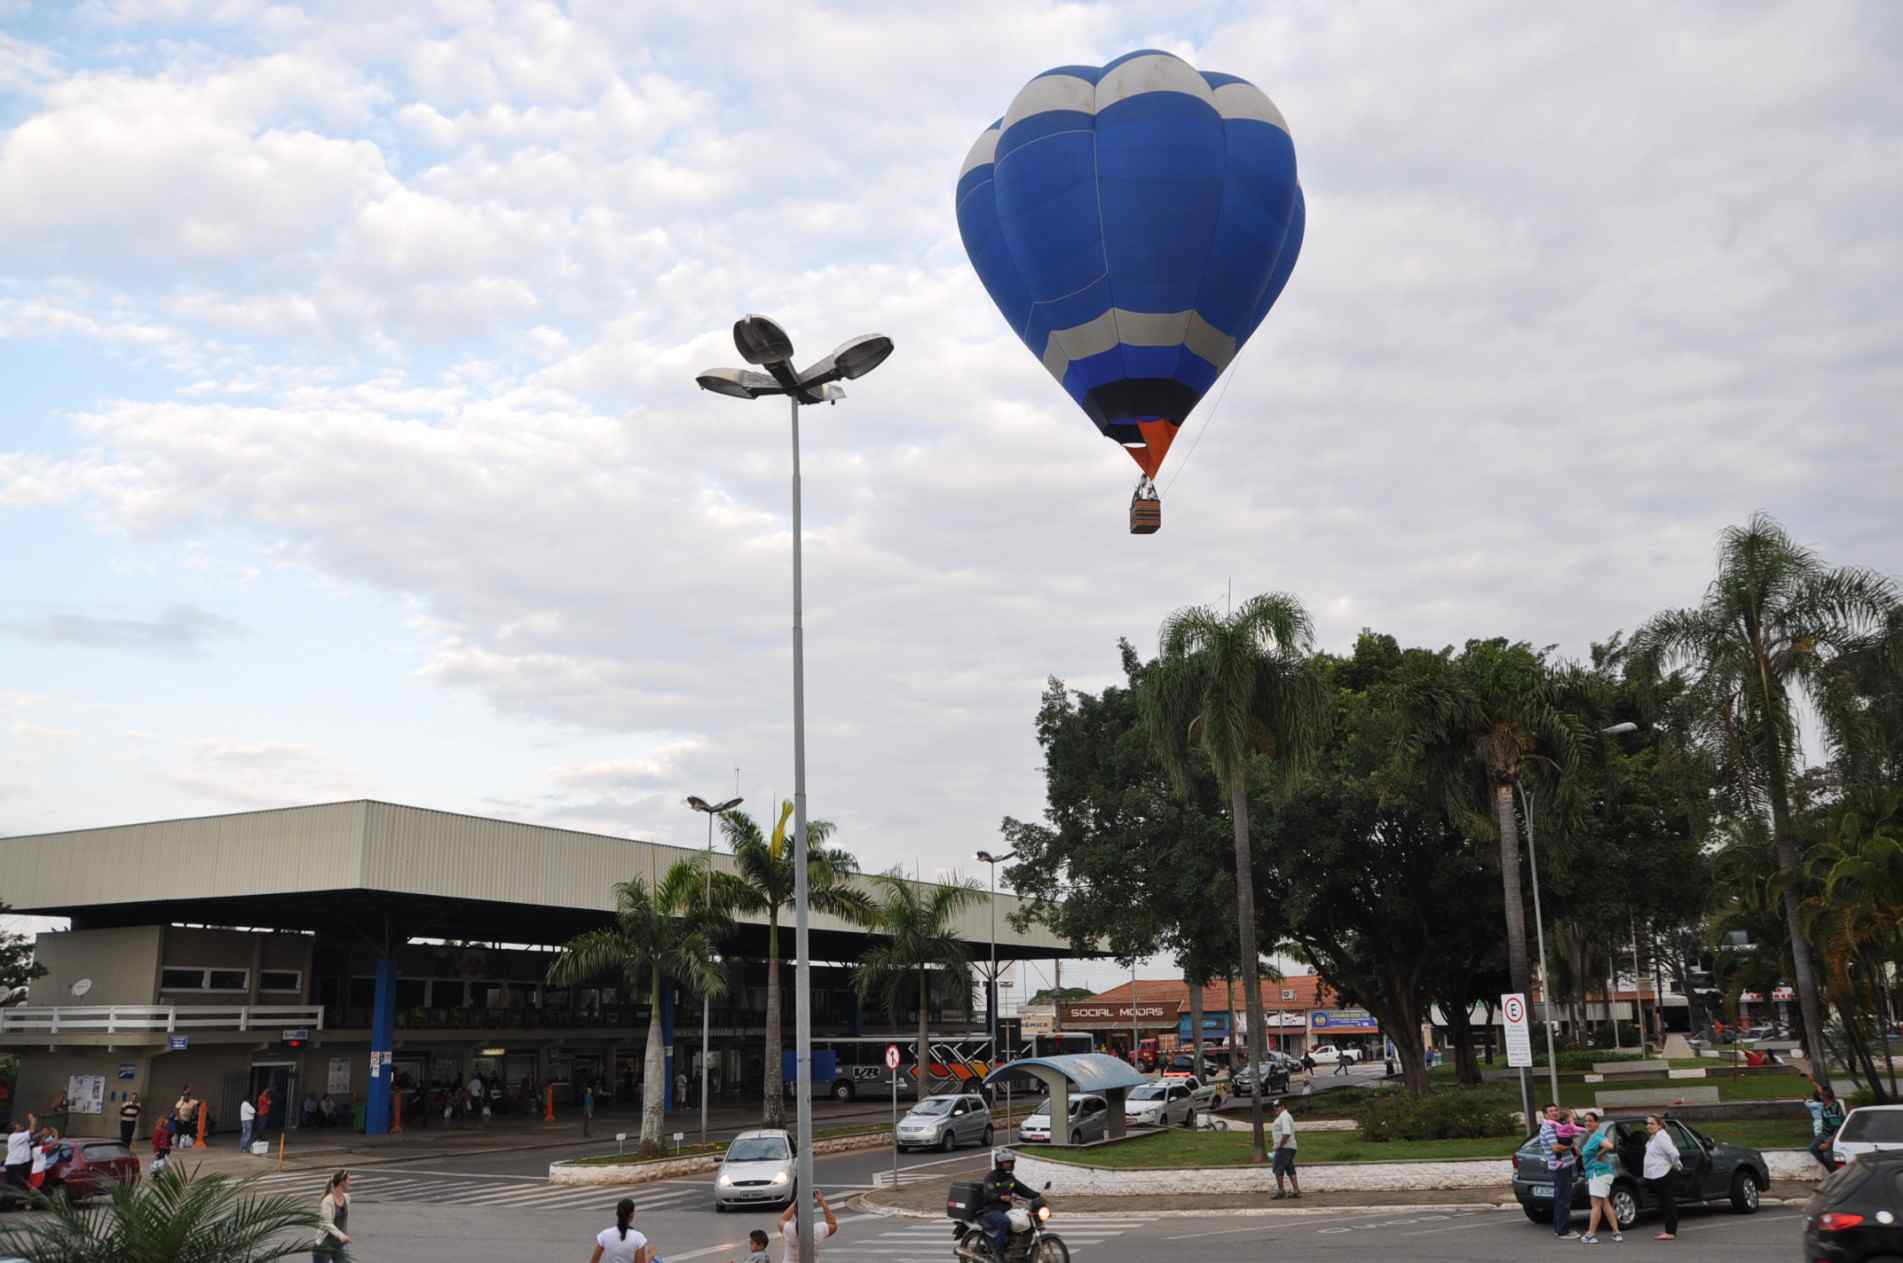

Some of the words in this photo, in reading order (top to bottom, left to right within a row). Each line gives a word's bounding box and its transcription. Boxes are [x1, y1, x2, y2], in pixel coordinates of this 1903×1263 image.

[1071, 1008, 1114, 1017] SOCIAL
[1119, 1007, 1163, 1017] MODAS
[1510, 1003, 1518, 1016] E
